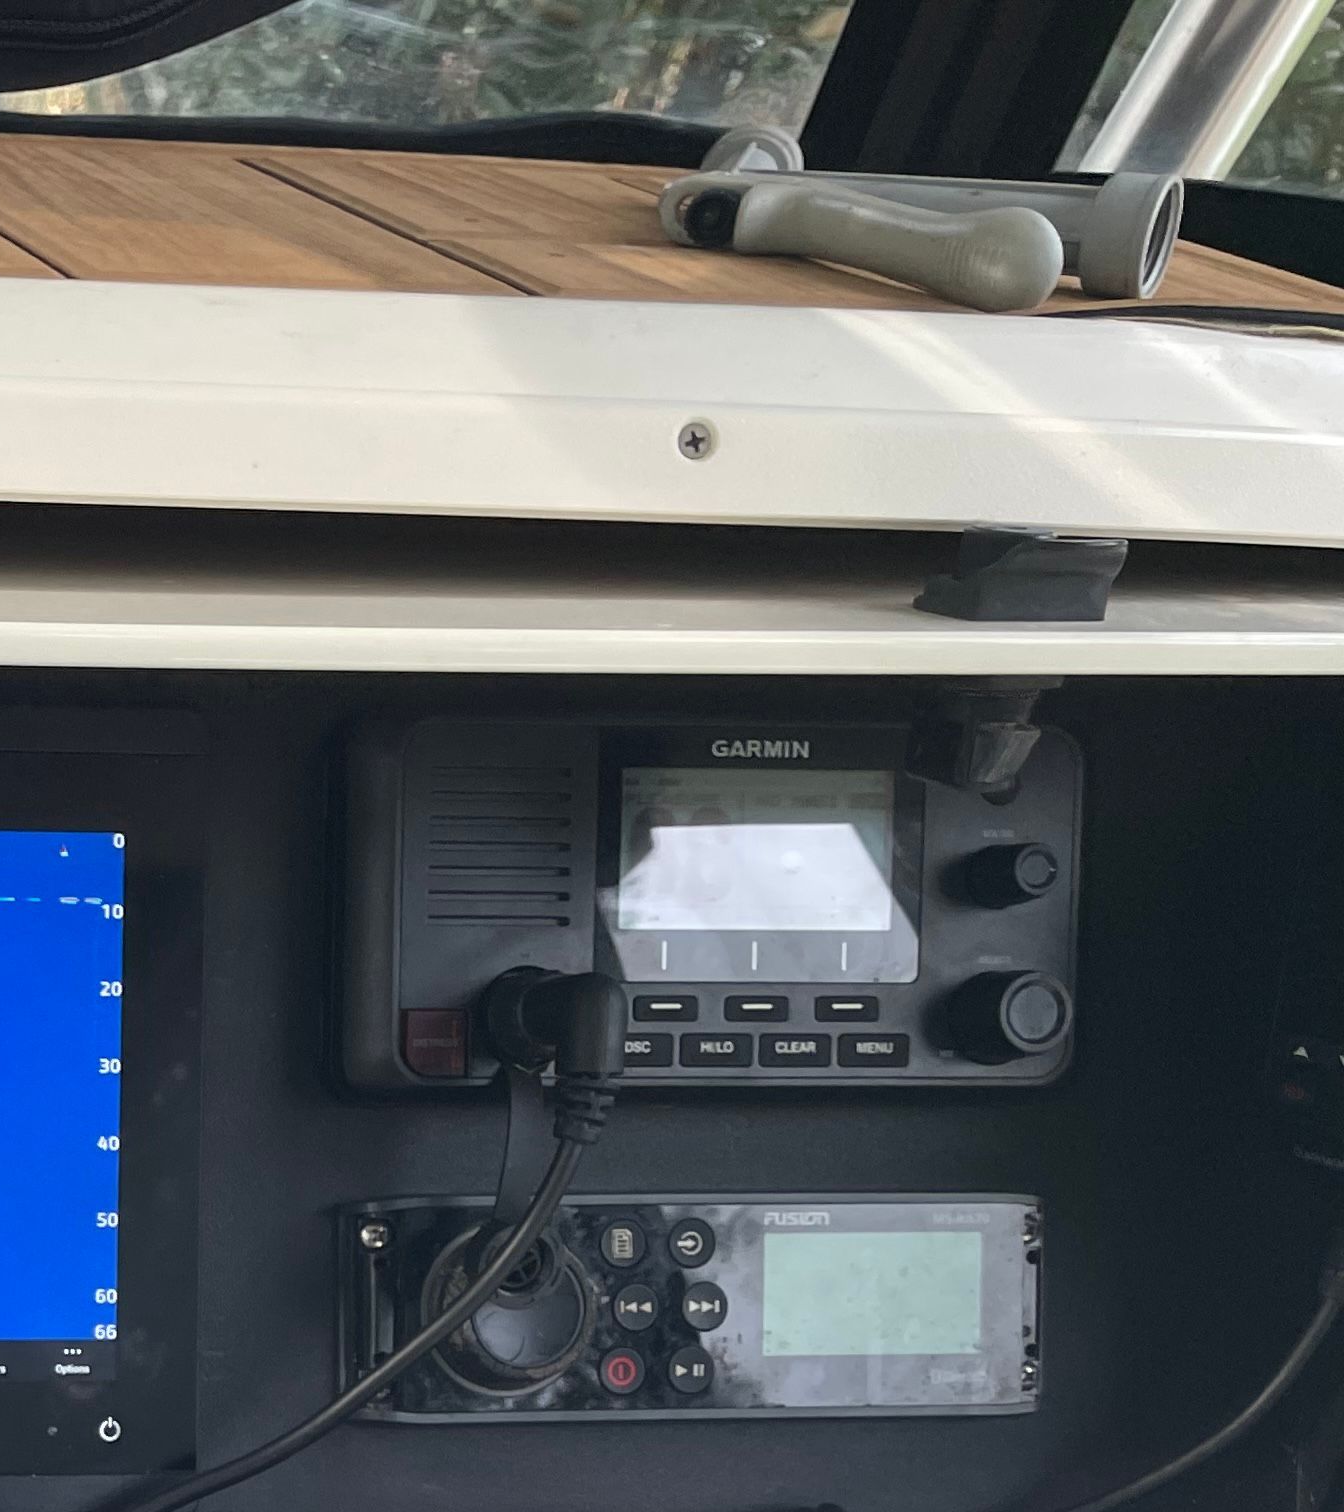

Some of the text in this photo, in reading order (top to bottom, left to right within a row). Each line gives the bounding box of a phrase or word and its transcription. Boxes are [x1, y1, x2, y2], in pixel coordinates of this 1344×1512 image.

[711, 740, 810, 759] GARMIN
[113, 832, 125, 850] 0
[100, 904, 124, 920] 10
[99, 980, 123, 998] 20
[774, 1041, 817, 1054] CLEAR
[856, 1042, 894, 1054] MENU
[98, 1058, 122, 1075] 30
[96, 1135, 120, 1152] 40
[95, 1212, 119, 1228] 50
[94, 1288, 118, 1305] 60
[94, 1324, 118, 1341] 66
[55, 1364, 91, 1377] Options
